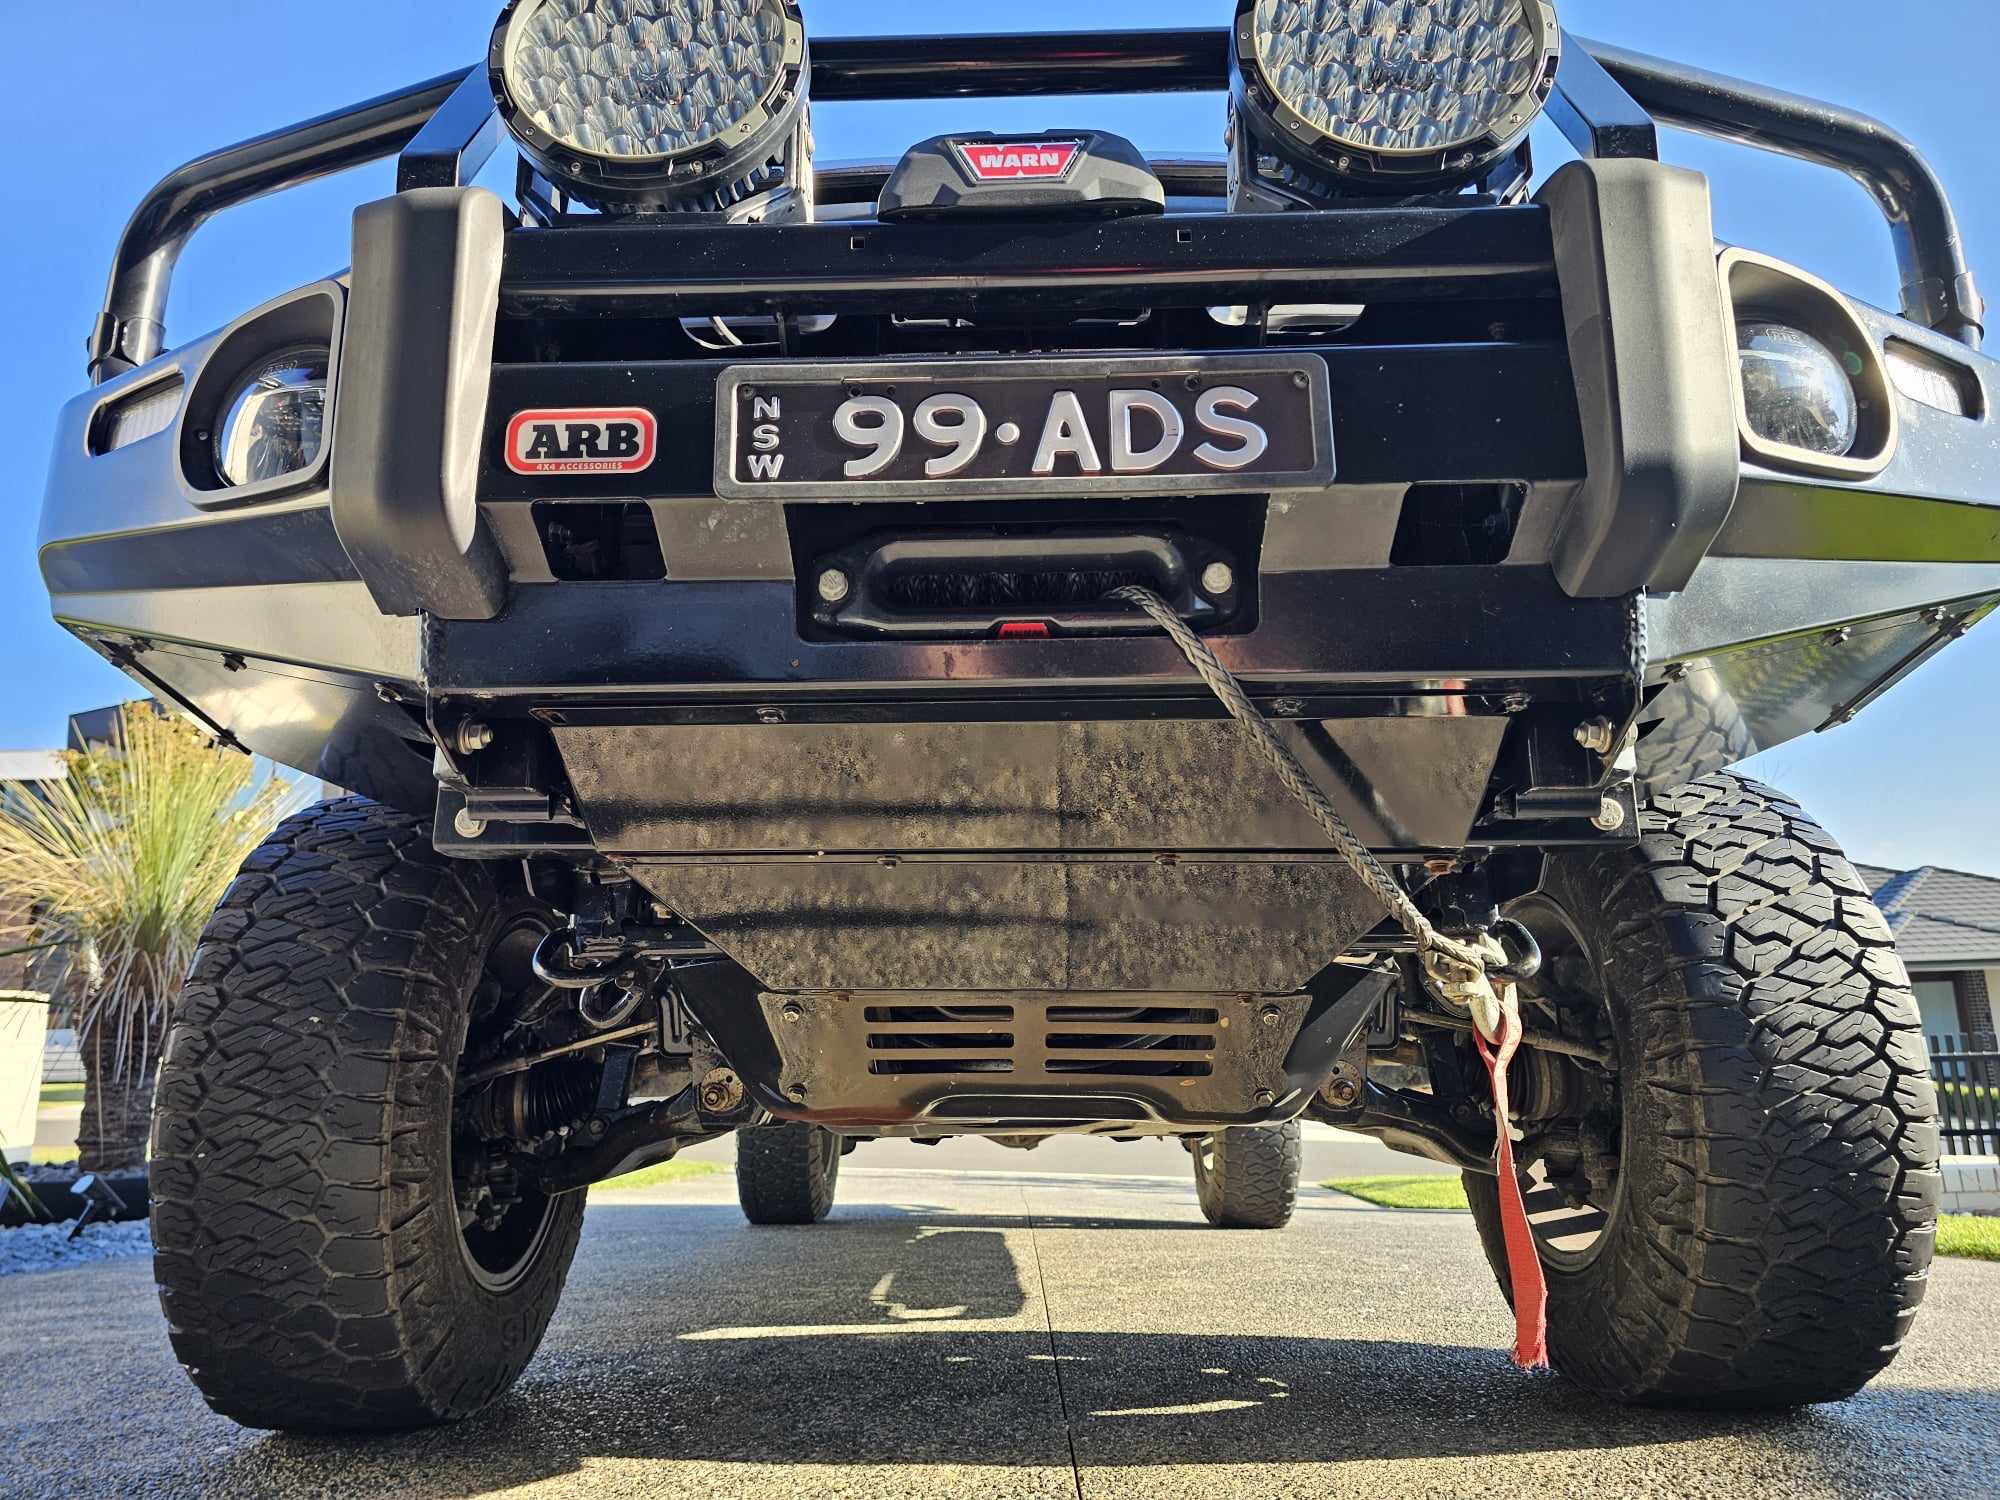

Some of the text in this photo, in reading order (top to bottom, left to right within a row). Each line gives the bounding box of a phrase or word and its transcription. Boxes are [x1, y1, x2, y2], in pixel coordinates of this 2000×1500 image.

[979, 151, 1059, 168] WARN
[525, 423, 640, 459] ARB
[747, 396, 784, 479] NSW
[559, 462, 623, 471] ACCESSORIES
